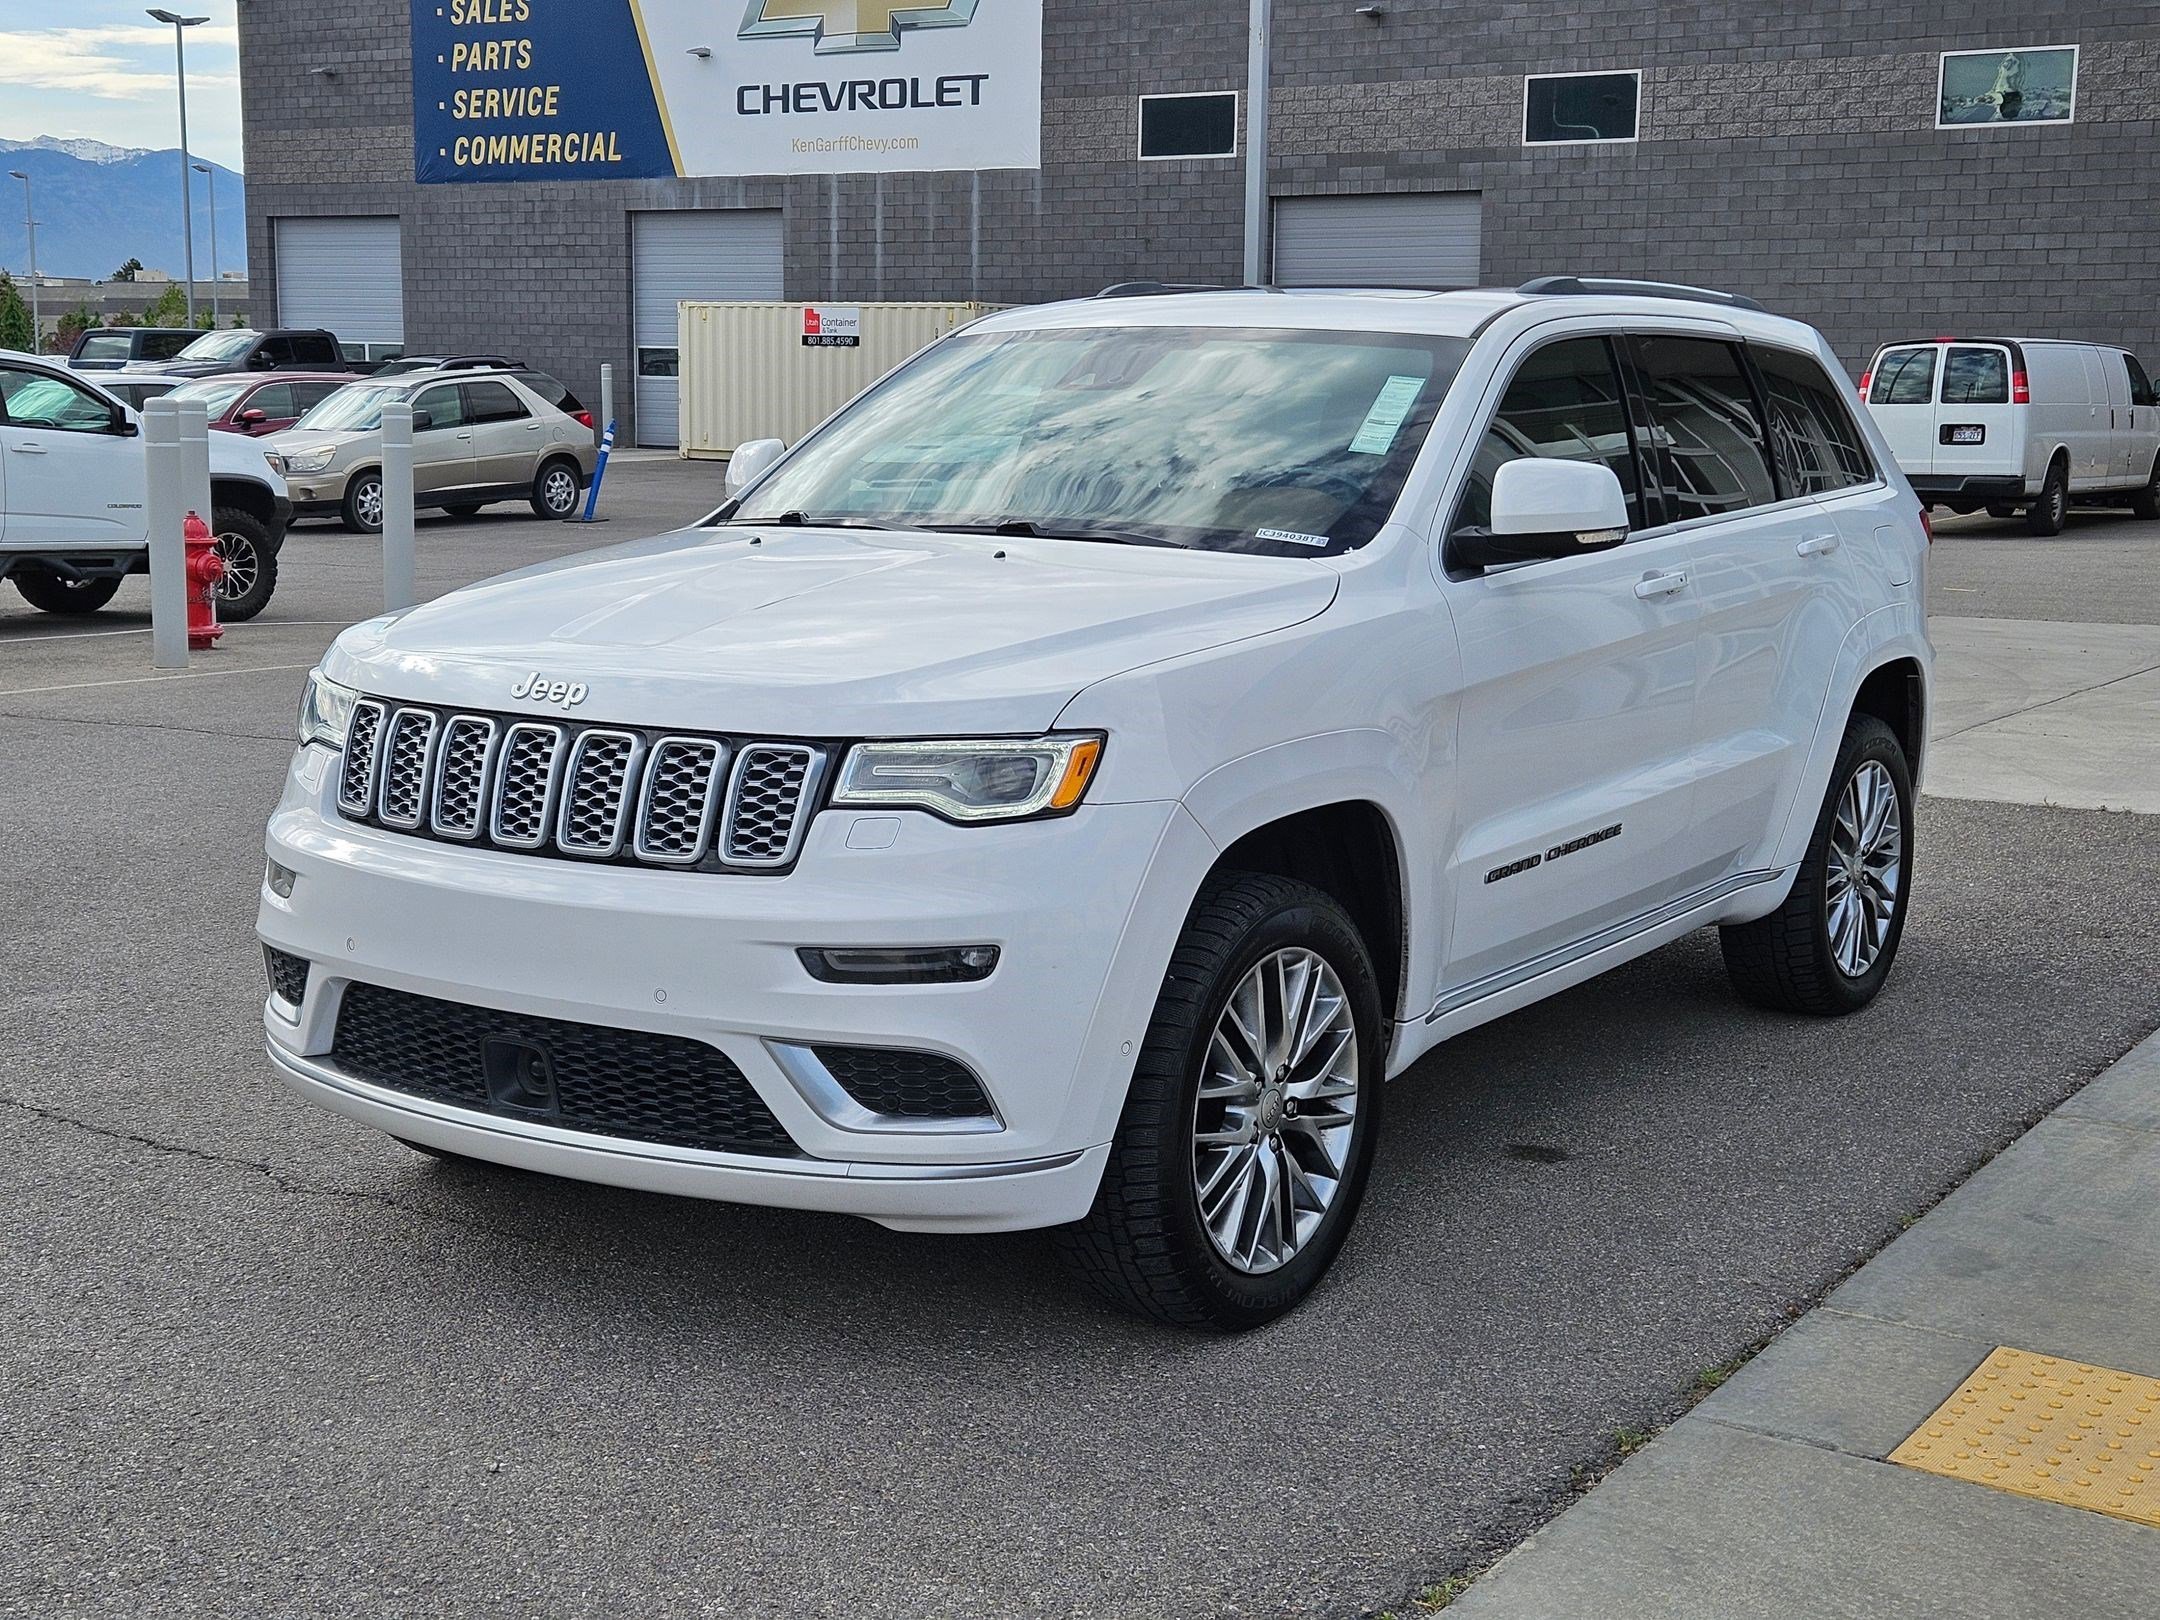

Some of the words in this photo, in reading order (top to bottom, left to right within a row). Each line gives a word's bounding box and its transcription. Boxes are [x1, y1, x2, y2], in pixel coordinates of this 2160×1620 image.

[450, 0, 529, 24] SALES
[451, 40, 532, 72] PARTS
[452, 86, 559, 119] SERVICE
[736, 74, 989, 115] CHEVROLET
[453, 132, 622, 166] COMMERCIAL
[791, 135, 919, 153] KenGarffChevy.com
[806, 319, 819, 327] Utah
[821, 317, 857, 327] Container
[807, 336, 854, 345] 801.885.4590
[510, 671, 589, 710] Jeep
[1484, 854, 1541, 884] GRAND
[1544, 822, 1623, 862] CHEROKEE
